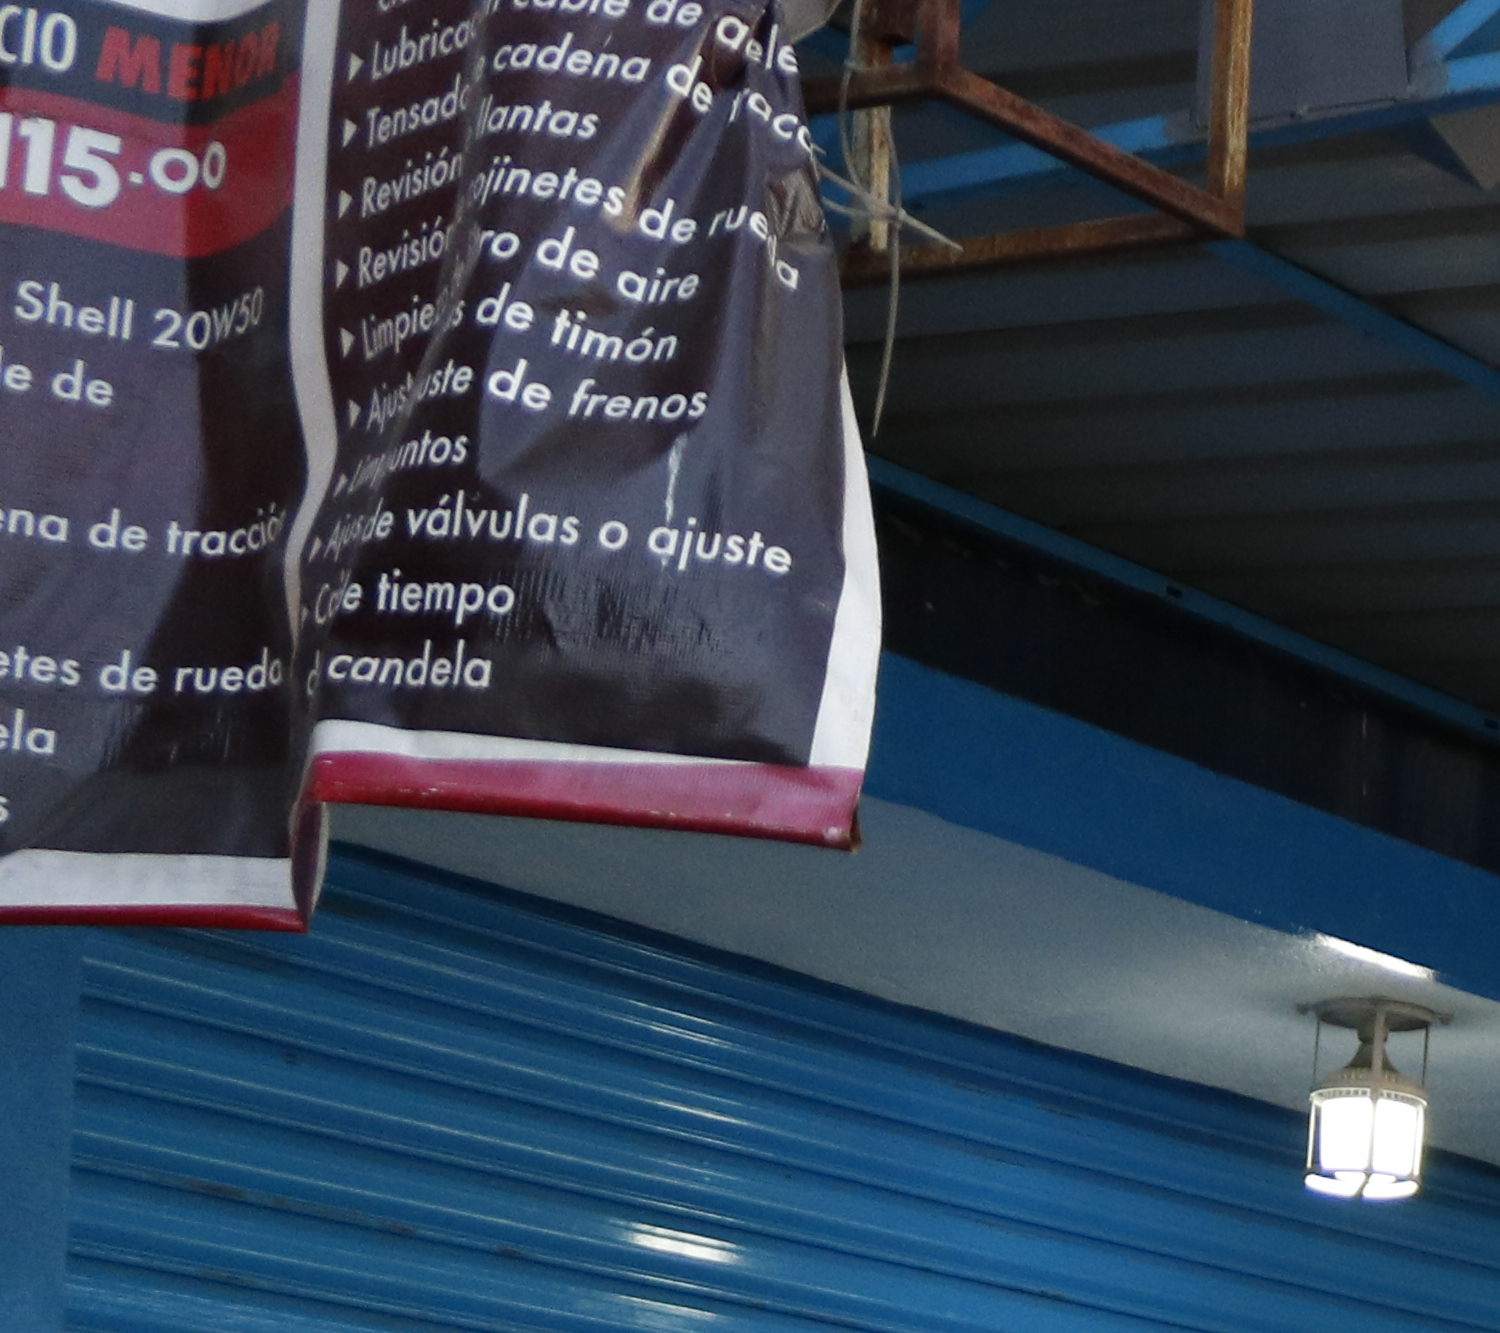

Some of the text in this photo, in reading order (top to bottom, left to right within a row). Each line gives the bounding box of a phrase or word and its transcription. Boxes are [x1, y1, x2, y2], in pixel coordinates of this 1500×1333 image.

[96, 21, 280, 101] MENOR
[371, 18, 477, 81] Lubrica
[493, 32, 651, 82] cadena
[667, 55, 713, 113] de
[476, 94, 599, 138] llantas
[361, 147, 463, 218] Revisión
[638, 198, 697, 243] de
[536, 226, 599, 278] de
[617, 267, 699, 302] aire
[15, 279, 264, 350] Shell 20W50
[361, 294, 437, 361] Limpie
[476, 282, 534, 331] de
[551, 308, 678, 361] timón
[51, 359, 113, 406] de
[488, 358, 552, 411] de
[568, 378, 708, 419] frenos
[88, 508, 149, 551] de
[407, 489, 792, 575] válvulas o ajuste
[377, 568, 515, 625] tiempo
[100, 649, 158, 692] de
[327, 638, 492, 688] candela
[0, 708, 57, 754] la
